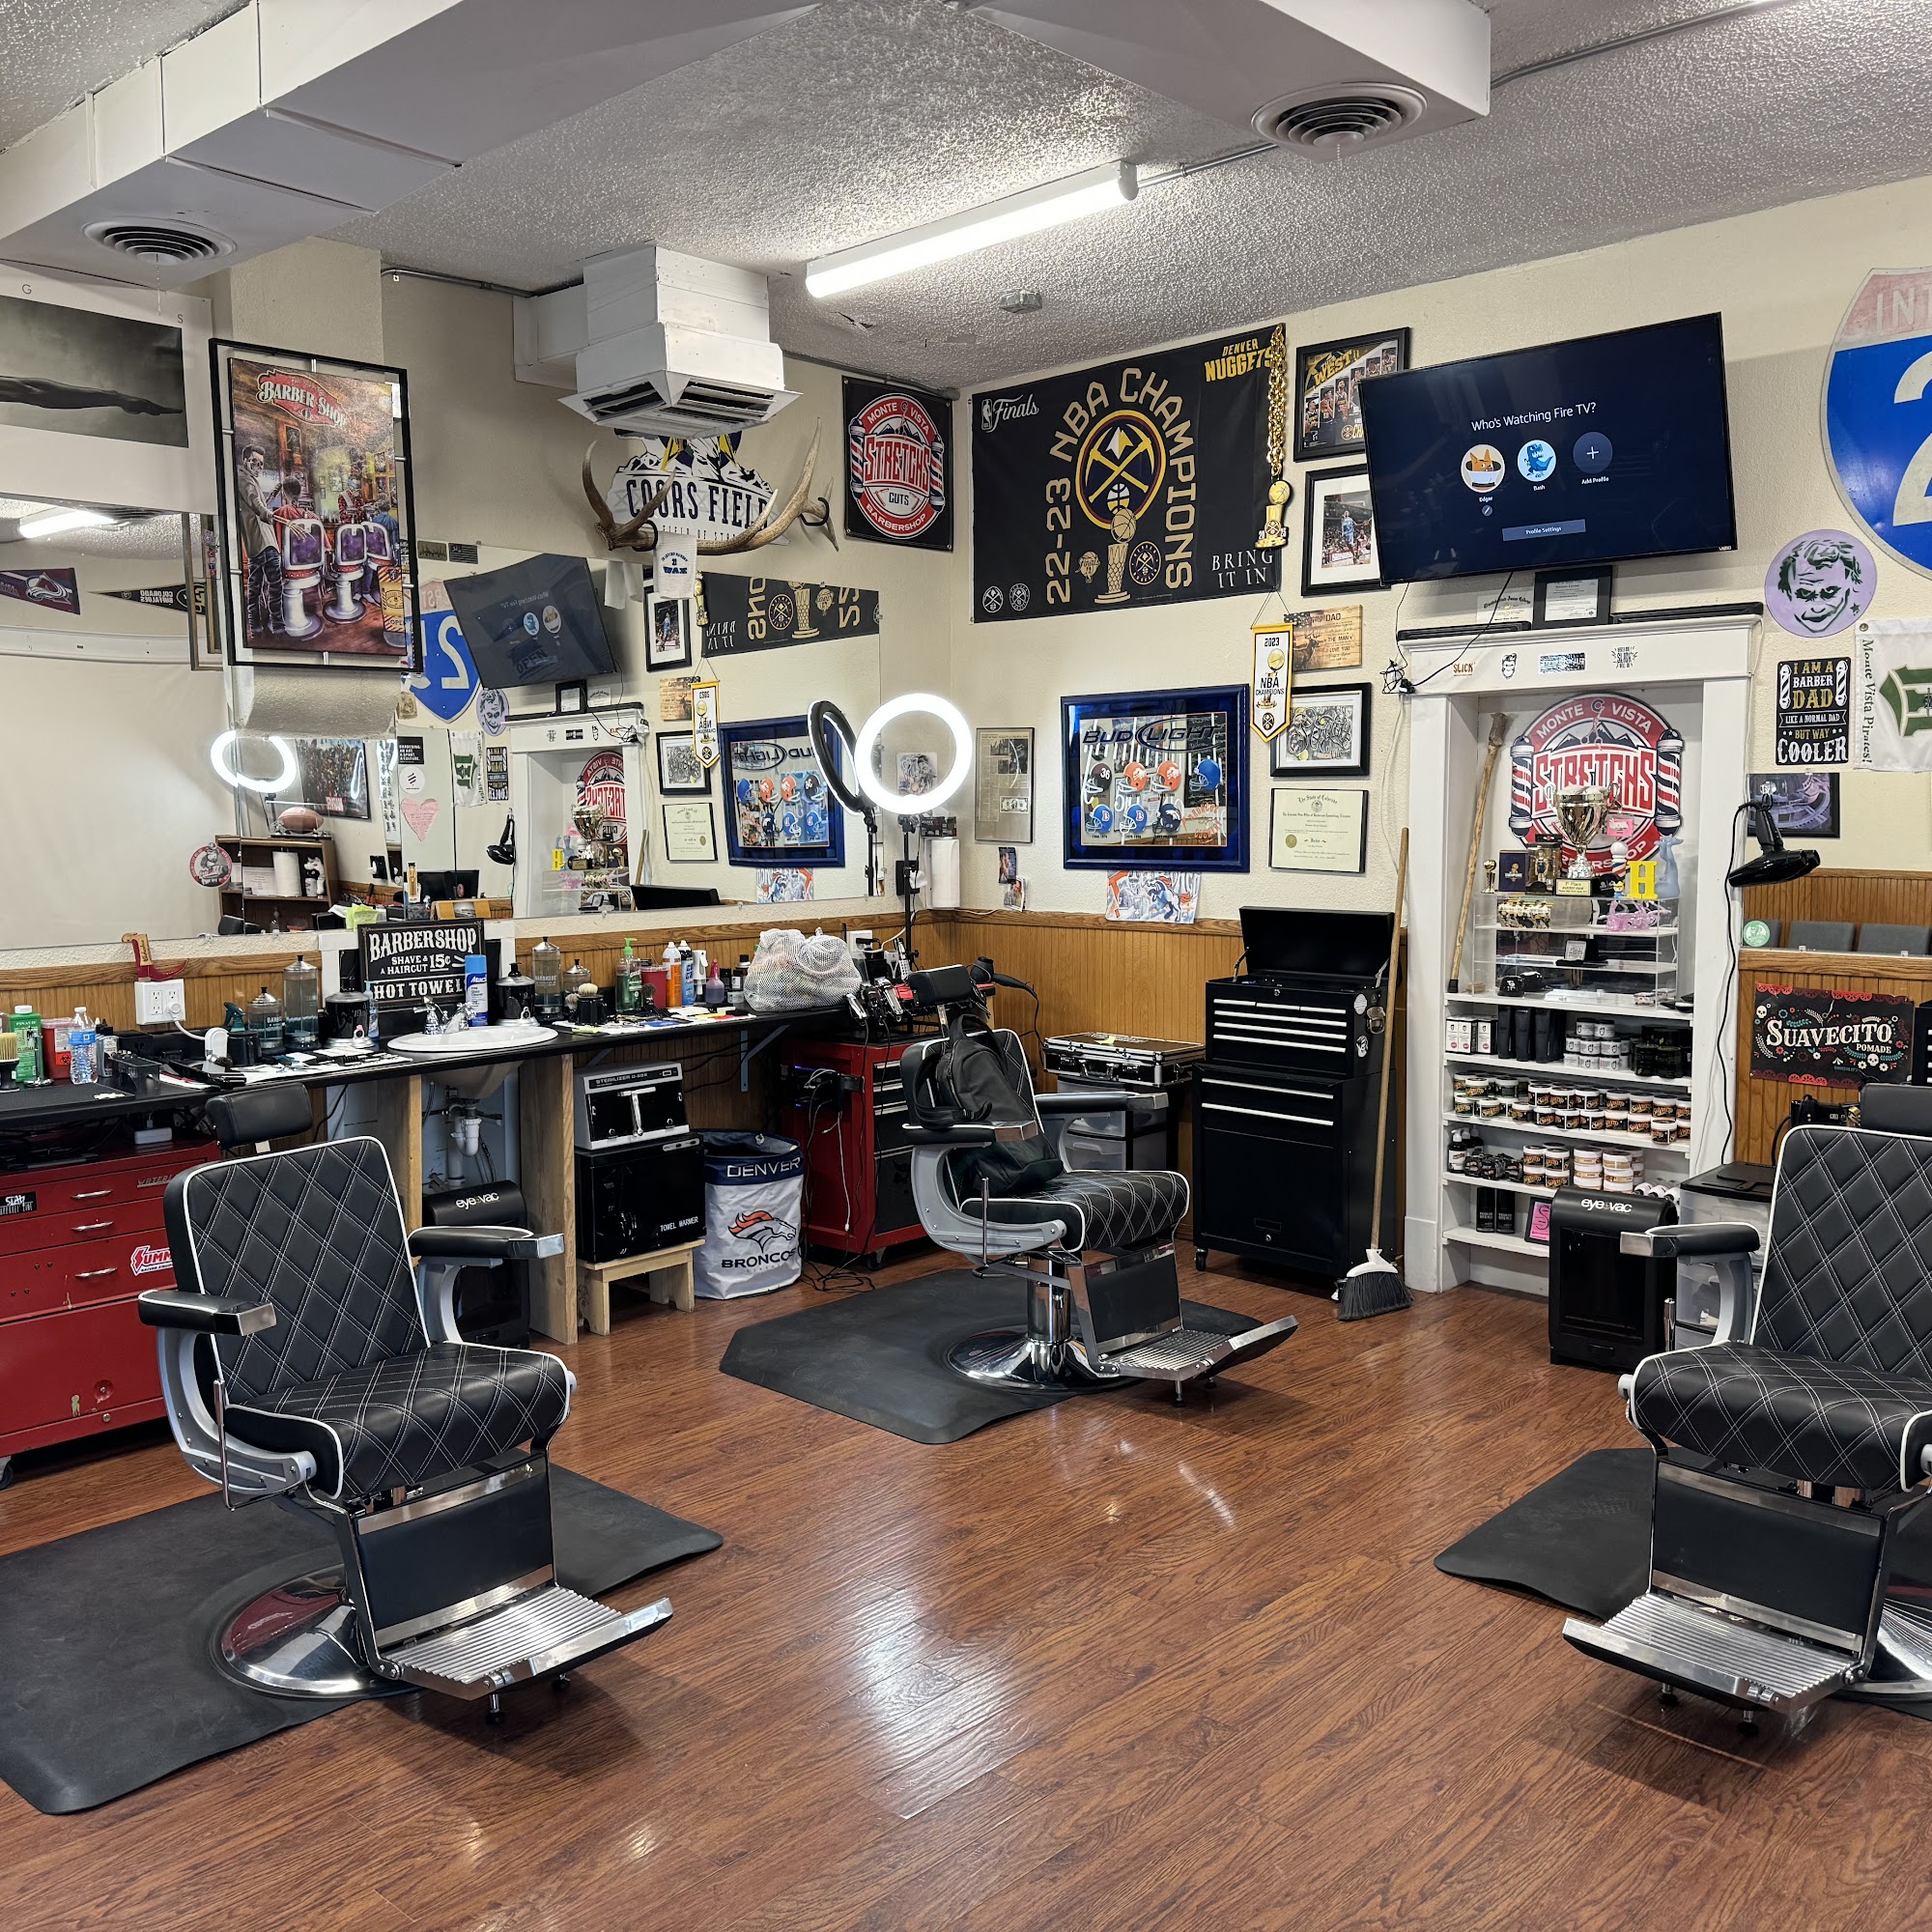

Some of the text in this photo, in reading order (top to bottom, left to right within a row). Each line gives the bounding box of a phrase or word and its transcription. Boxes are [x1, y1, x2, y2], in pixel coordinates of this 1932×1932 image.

[1222, 338, 1258, 356] DENVER
[1205, 347, 1272, 383] NUGGETS
[257, 382, 348, 429] BARBER SHOP
[987, 394, 1039, 433] Finals
[867, 402, 929, 436] MONTE VISTA
[1471, 402, 1597, 431] Who's Watching Fire TV?
[865, 435, 931, 492] STRETCHS
[1049, 367, 1197, 589] NBA CHAMPIONS
[626, 479, 698, 520] COORS
[889, 492, 909, 506] CUTS
[866, 503, 926, 531] BARBERSHOP
[1046, 477, 1071, 605] 22-23
[1212, 548, 1273, 571] BRING
[1219, 568, 1267, 588] IT IN
[1325, 612, 1342, 622] DAD
[1264, 638, 1280, 647] 2023
[1453, 663, 1473, 673] SLICK
[1794, 661, 1833, 674] I AM A
[1261, 677, 1280, 688] NBA
[1793, 674, 1833, 688] BARBER
[1792, 688, 1833, 710] DAD
[1861, 639, 1876, 763] Monte Vista Pirates!
[1536, 703, 1652, 738] MONTE VISTA
[1785, 713, 1840, 724] LIKE A NORMAL DAD
[1082, 725, 1216, 744] BUD LIGHT
[1795, 727, 1830, 740] BUT WAY
[1777, 736, 1848, 763] COOLER
[1100, 768, 1111, 780] 36
[369, 927, 476, 962] BARBERSHOP
[387, 963, 428, 975] HAIRCUT
[391, 954, 421, 965] SHAVE
[429, 953, 451, 969] 15¢
[373, 982, 406, 1001] HOT
[1766, 1019, 1892, 1047] SUAVECITO
[1856, 1042, 1892, 1054] POMADE
[596, 1074, 631, 1086] STERILIZER
[726, 1156, 801, 1178] DENVER
[660, 1216, 698, 1232] TOWEL WARMER
